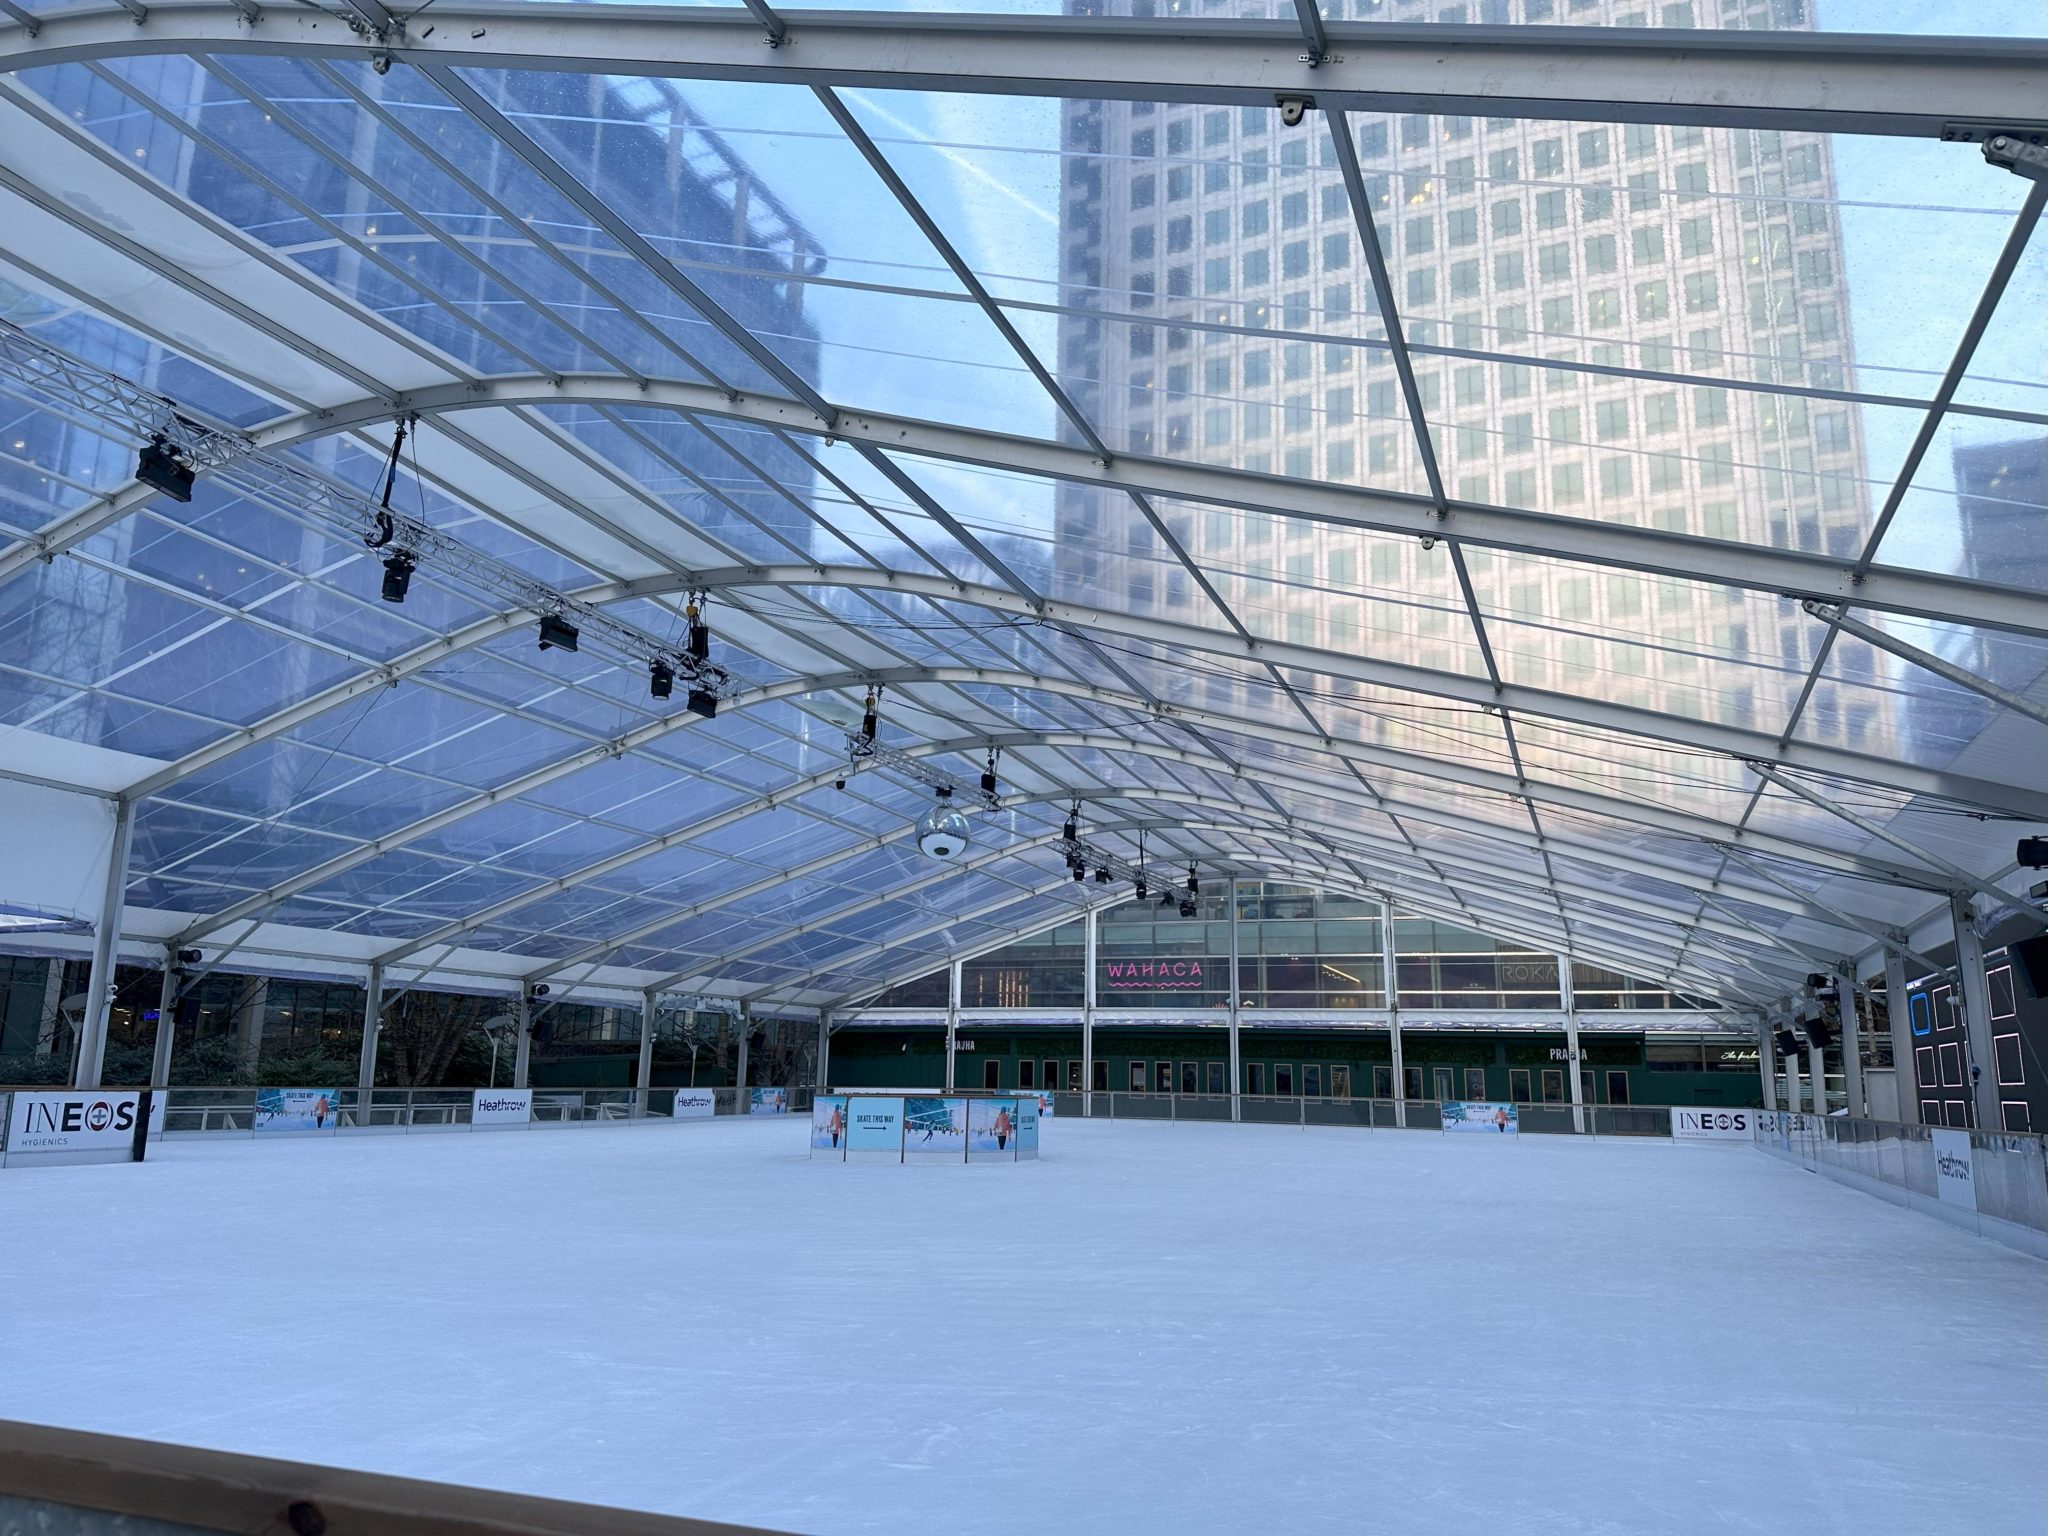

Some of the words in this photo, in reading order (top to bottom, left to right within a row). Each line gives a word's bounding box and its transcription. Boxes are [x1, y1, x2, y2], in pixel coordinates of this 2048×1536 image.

[1107, 962, 1202, 977] WAHACA
[1502, 966, 1558, 980] ROKA
[1550, 1048, 1588, 1060] PRAA
[478, 1098, 526, 1112] Heathrow
[678, 1096, 712, 1107] Heathrow
[23, 1101, 136, 1133] INEOS
[857, 1114, 871, 1123] SKATE
[872, 1115, 883, 1123] THIS
[884, 1115, 894, 1123] WAY
[1680, 1112, 1746, 1131] INEOS
[21, 1137, 68, 1147] HYGIENICS
[1937, 1150, 1970, 1180] Heathrow
